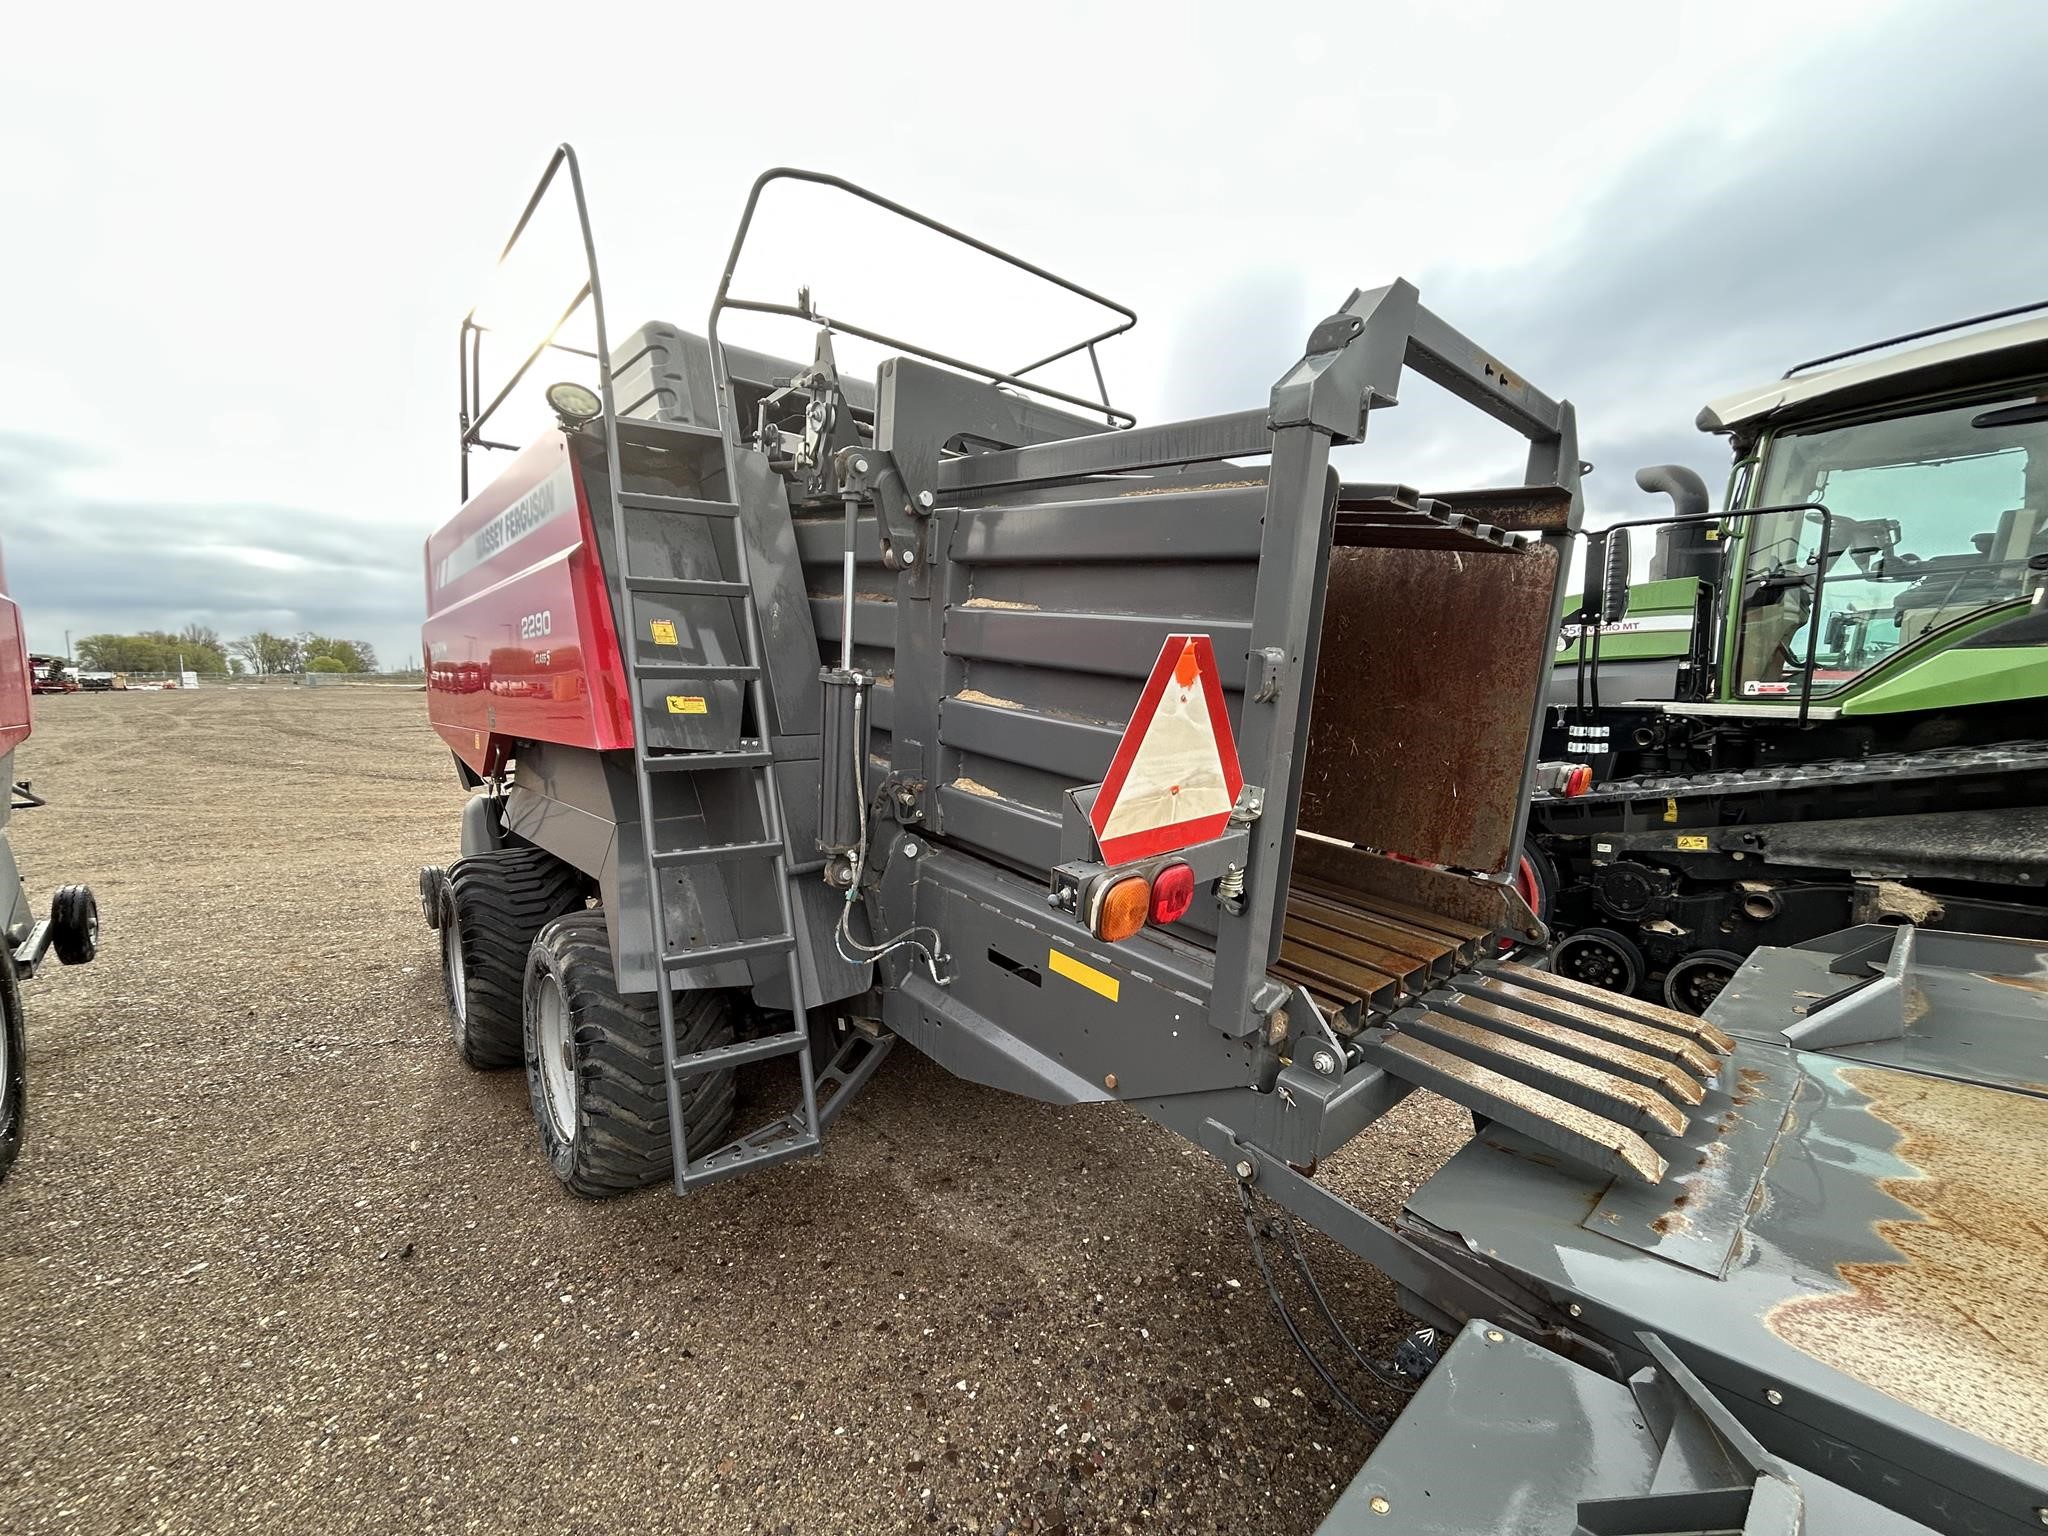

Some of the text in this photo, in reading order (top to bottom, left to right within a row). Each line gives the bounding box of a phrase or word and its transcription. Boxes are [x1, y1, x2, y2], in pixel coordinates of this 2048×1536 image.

[505, 480, 554, 541] FERGUSON
[521, 610, 550, 639] 2290
[1588, 624, 1620, 633] VRIO
[1623, 622, 1639, 631] MT
